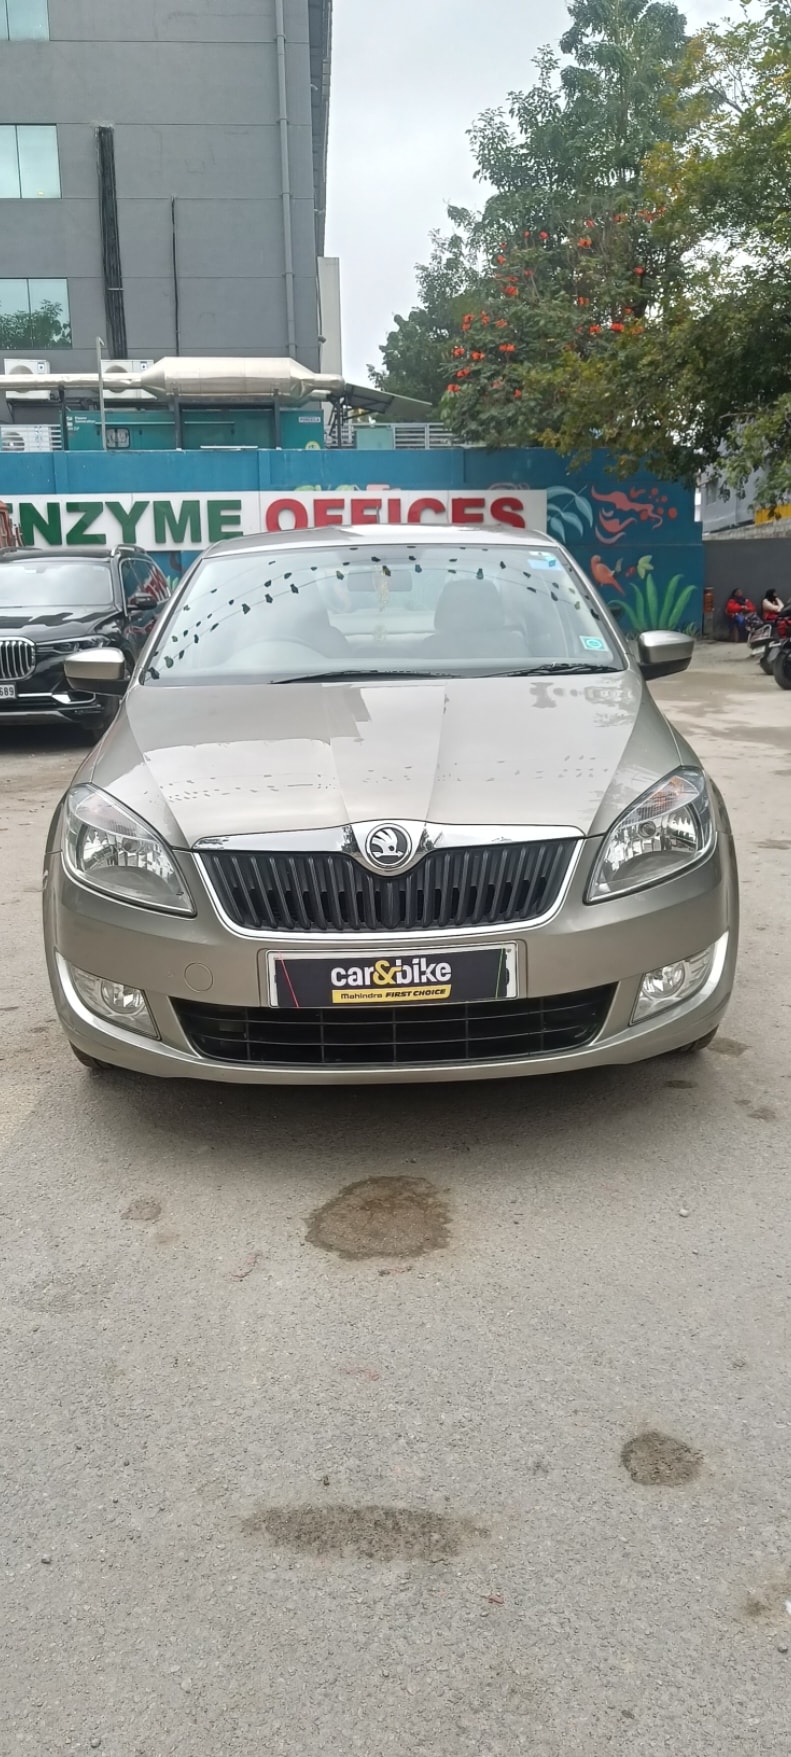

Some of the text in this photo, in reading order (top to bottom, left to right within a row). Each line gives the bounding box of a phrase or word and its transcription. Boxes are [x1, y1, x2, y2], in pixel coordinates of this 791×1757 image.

[6, 500, 244, 545] NZYME
[330, 957, 452, 987] car&bike
[385, 990, 412, 998] FIRST
[412, 988, 446, 997] CHOICE
